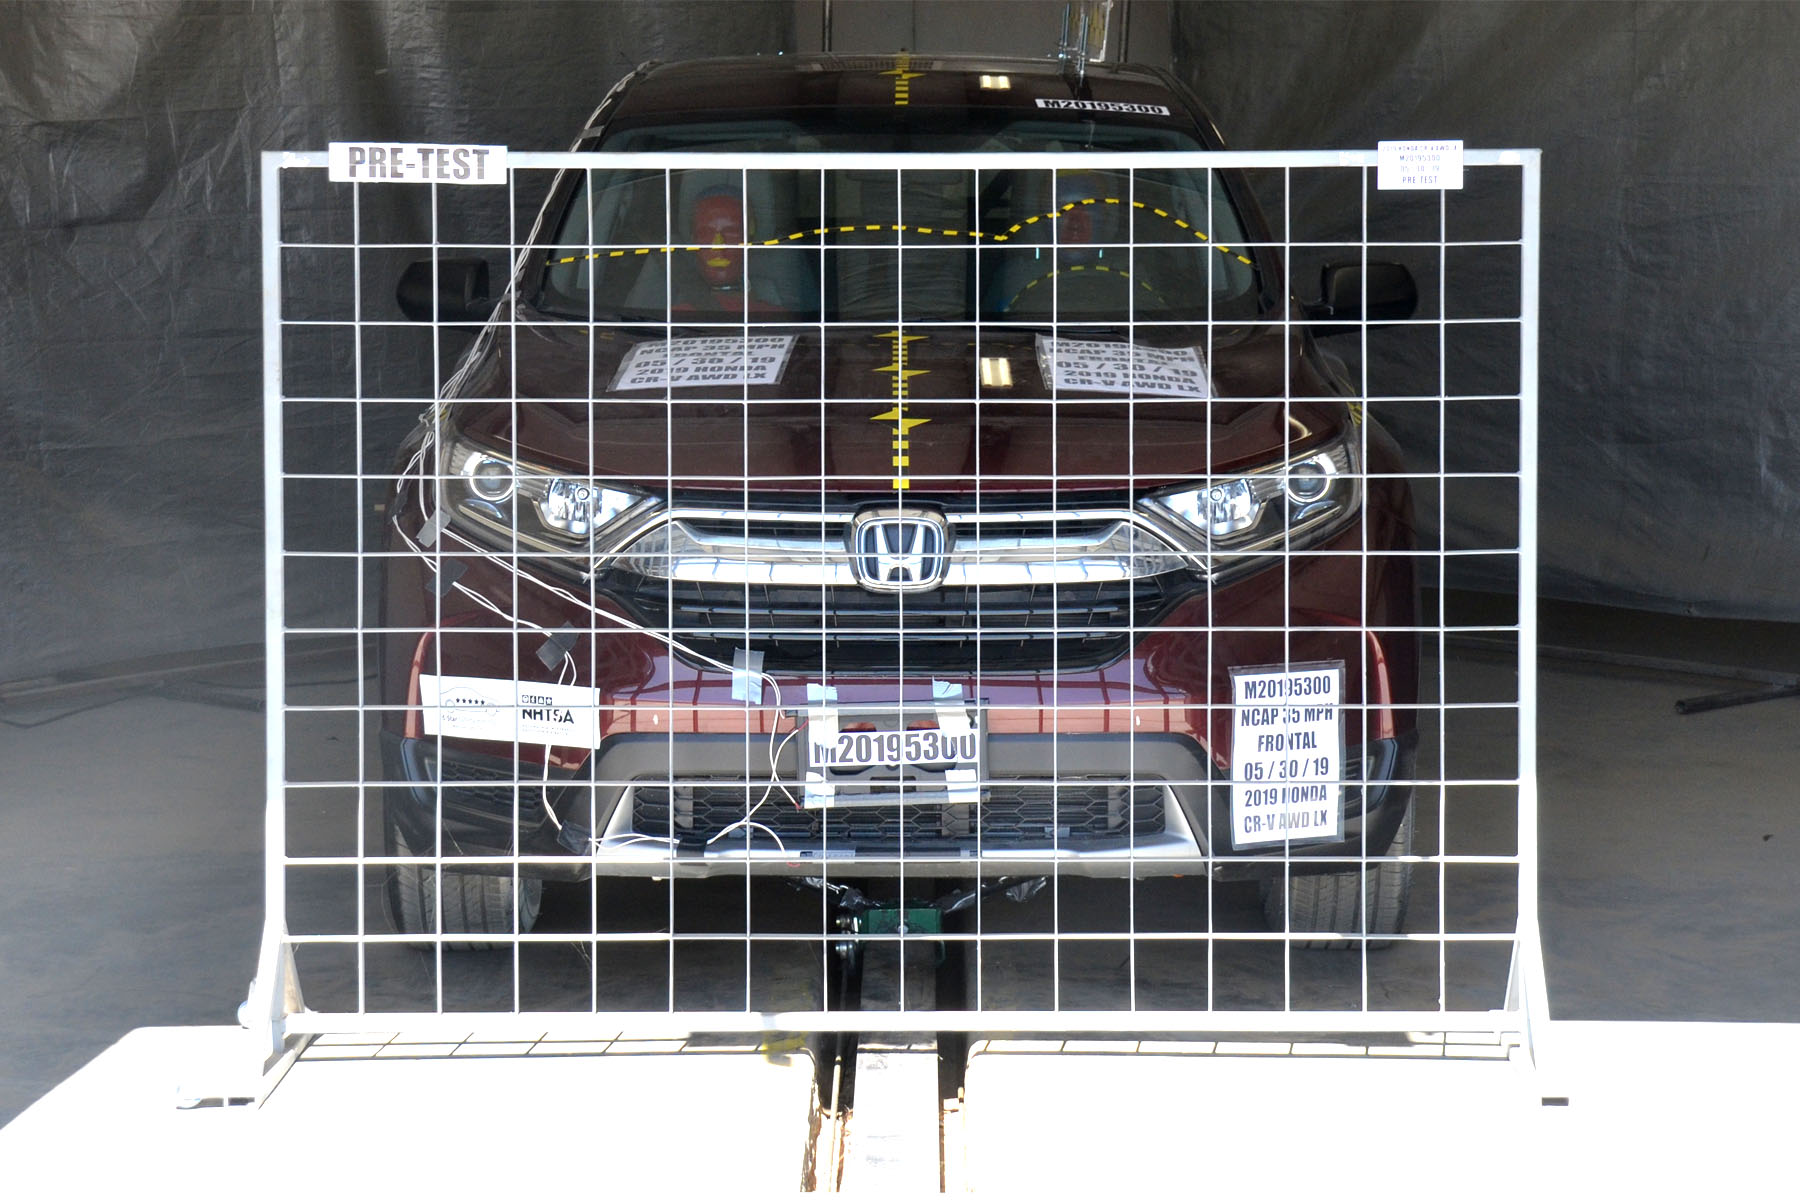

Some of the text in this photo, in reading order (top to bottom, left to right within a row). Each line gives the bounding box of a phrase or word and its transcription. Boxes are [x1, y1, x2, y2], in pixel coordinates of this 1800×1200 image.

[1043, 100, 1164, 114] M20195300
[348, 147, 489, 180] PRE-TEST
[1051, 341, 1188, 355] M201900
[635, 360, 667, 368] 05
[636, 365, 767, 376] 2019 HONDA
[1056, 361, 1089, 369] 05
[1112, 363, 1146, 371] 30
[686, 372, 738, 381] AWD
[1064, 370, 1196, 384] 2019 HONDA
[1244, 675, 1331, 699] M20195300
[522, 708, 574, 724] NHTSA
[1241, 708, 1279, 726] NCAP
[1304, 703, 1333, 722] MPH
[814, 732, 976, 764] M20195300
[1258, 731, 1317, 752] FRONTAL
[1244, 762, 1264, 781] 05
[1279, 760, 1298, 778] 30
[1313, 757, 1329, 776] 19
[1245, 785, 1327, 807] 2019 HONDA
[1244, 810, 1328, 833] CR-V AWD LX
